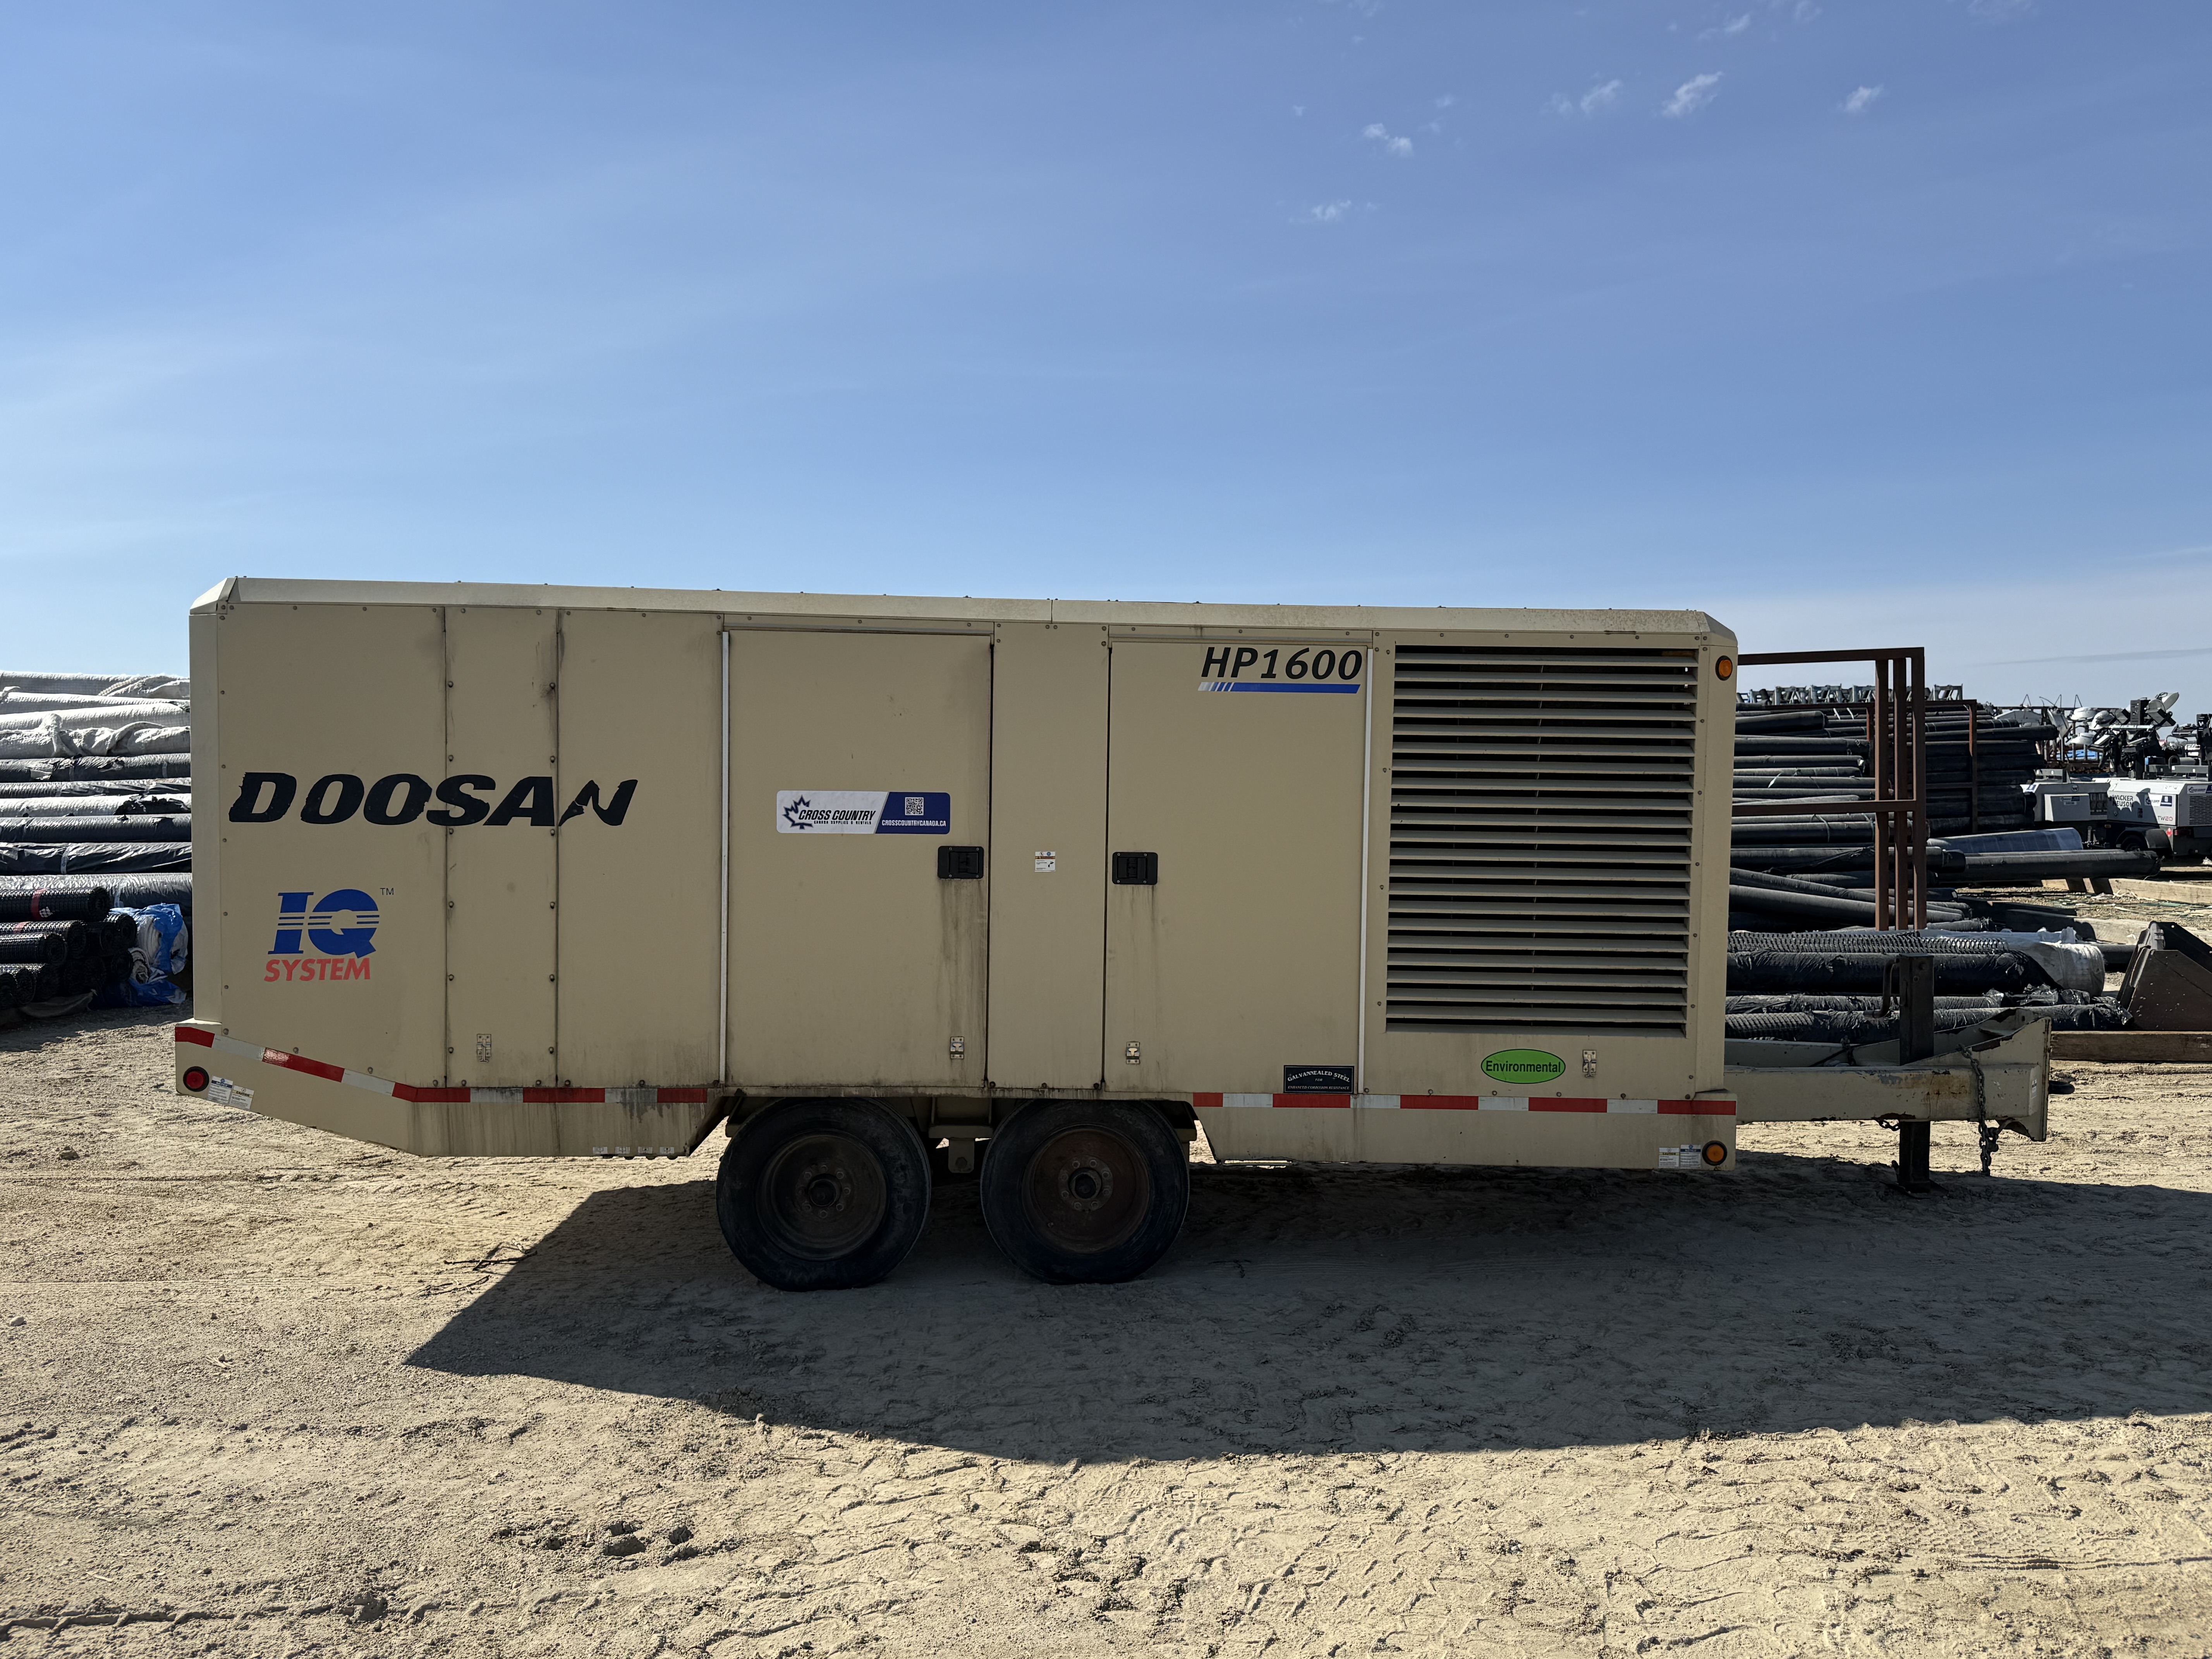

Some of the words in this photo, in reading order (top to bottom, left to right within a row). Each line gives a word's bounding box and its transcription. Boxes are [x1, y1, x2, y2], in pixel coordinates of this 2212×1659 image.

[1201, 647, 1362, 680] HP1600
[229, 772, 638, 827] DOOSAN
[799, 810, 831, 820] CROSS
[832, 810, 876, 821] COUNTRY
[267, 888, 380, 958] IQ
[264, 957, 370, 982] SYSTEM
[1287, 1070, 1333, 1082] GALVANNEALED
[1333, 1073, 1350, 1082] STEEL
[1486, 1060, 1561, 1073] Environmental
